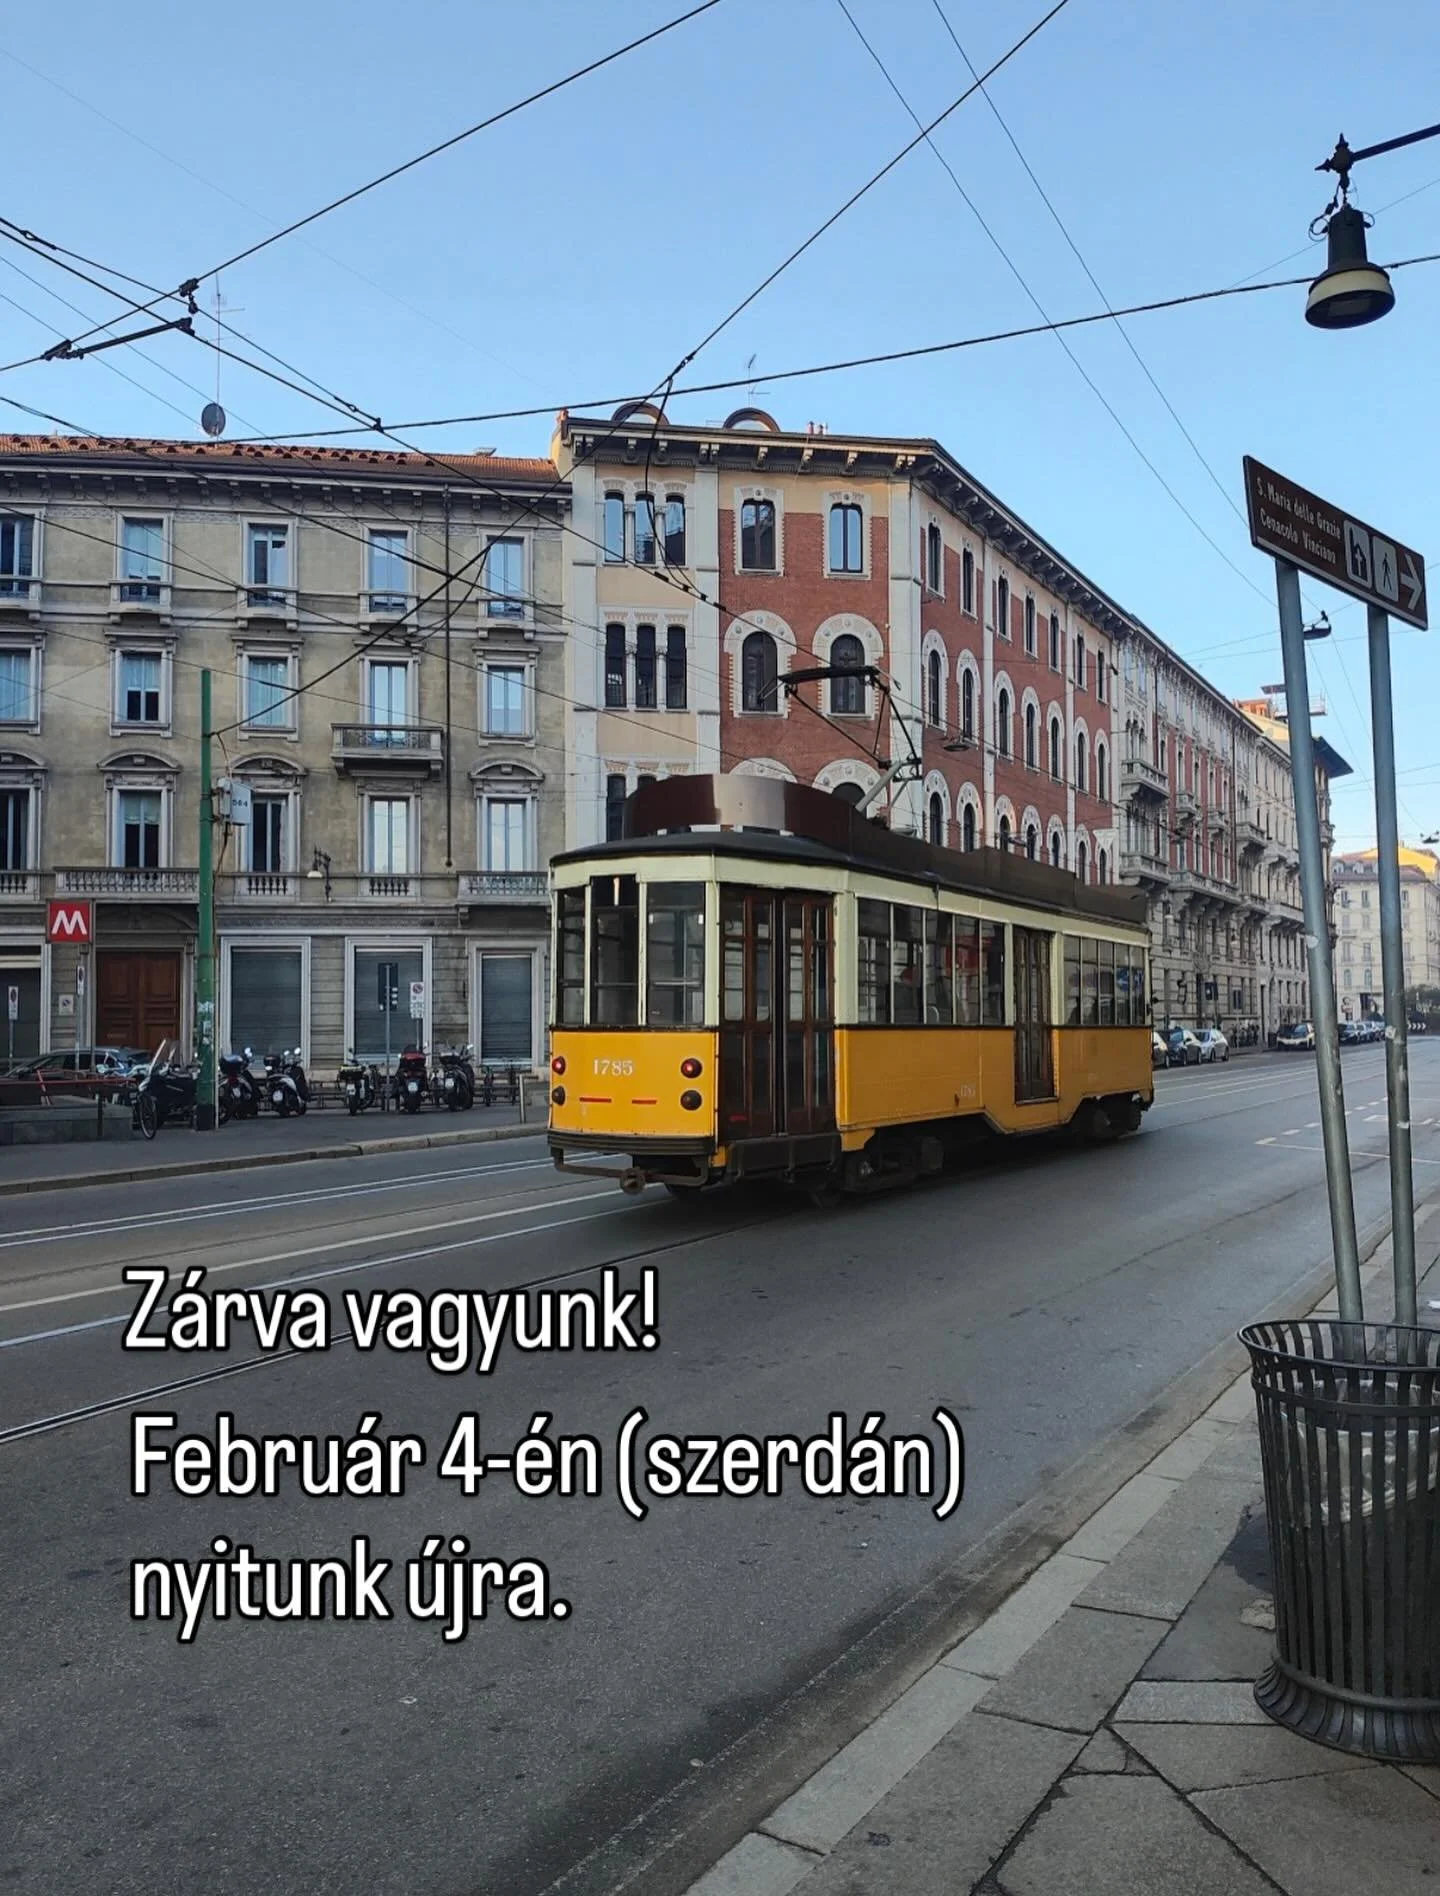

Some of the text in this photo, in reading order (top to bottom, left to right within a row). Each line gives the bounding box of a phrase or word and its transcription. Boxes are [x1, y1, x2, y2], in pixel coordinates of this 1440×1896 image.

[1256, 477, 1340, 540] S. Maria delle Grazie
[1260, 507, 1336, 564] Cenacolo Vinciano
[51, 909, 88, 935] M
[592, 1058, 634, 1077] 1785
